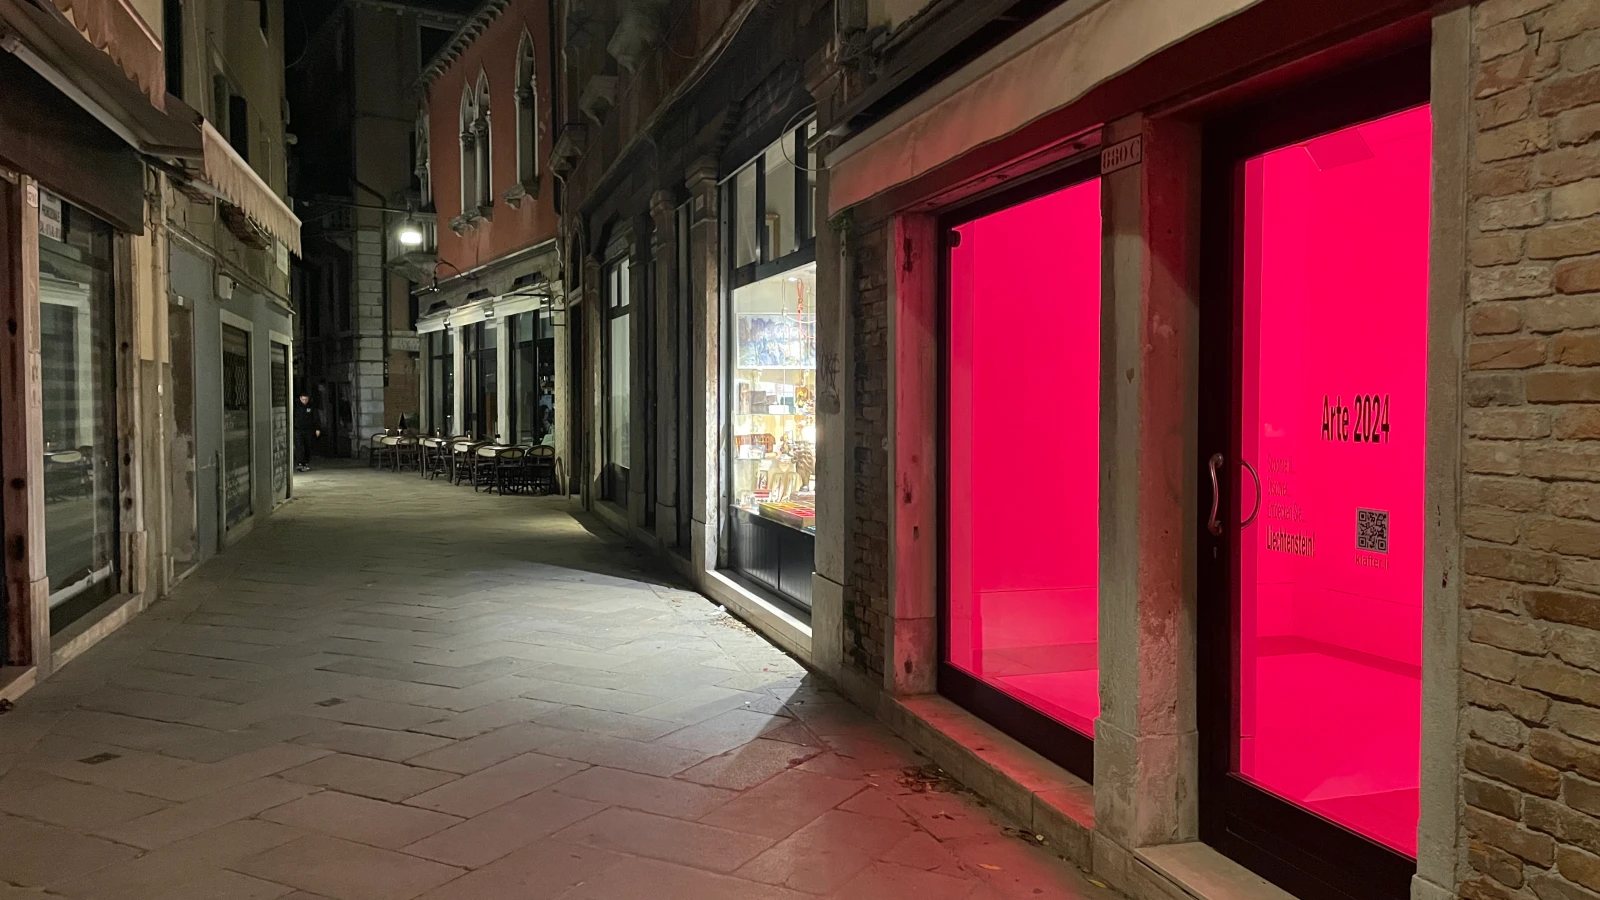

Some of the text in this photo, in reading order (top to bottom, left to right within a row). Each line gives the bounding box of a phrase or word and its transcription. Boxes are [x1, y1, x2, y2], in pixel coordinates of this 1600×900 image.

[1321, 393, 1390, 444] Arte 2024
[1267, 499, 1292, 521] Entdecken
[1266, 525, 1315, 557] Liechtenstein!
[1355, 552, 1389, 570] klafter.li
